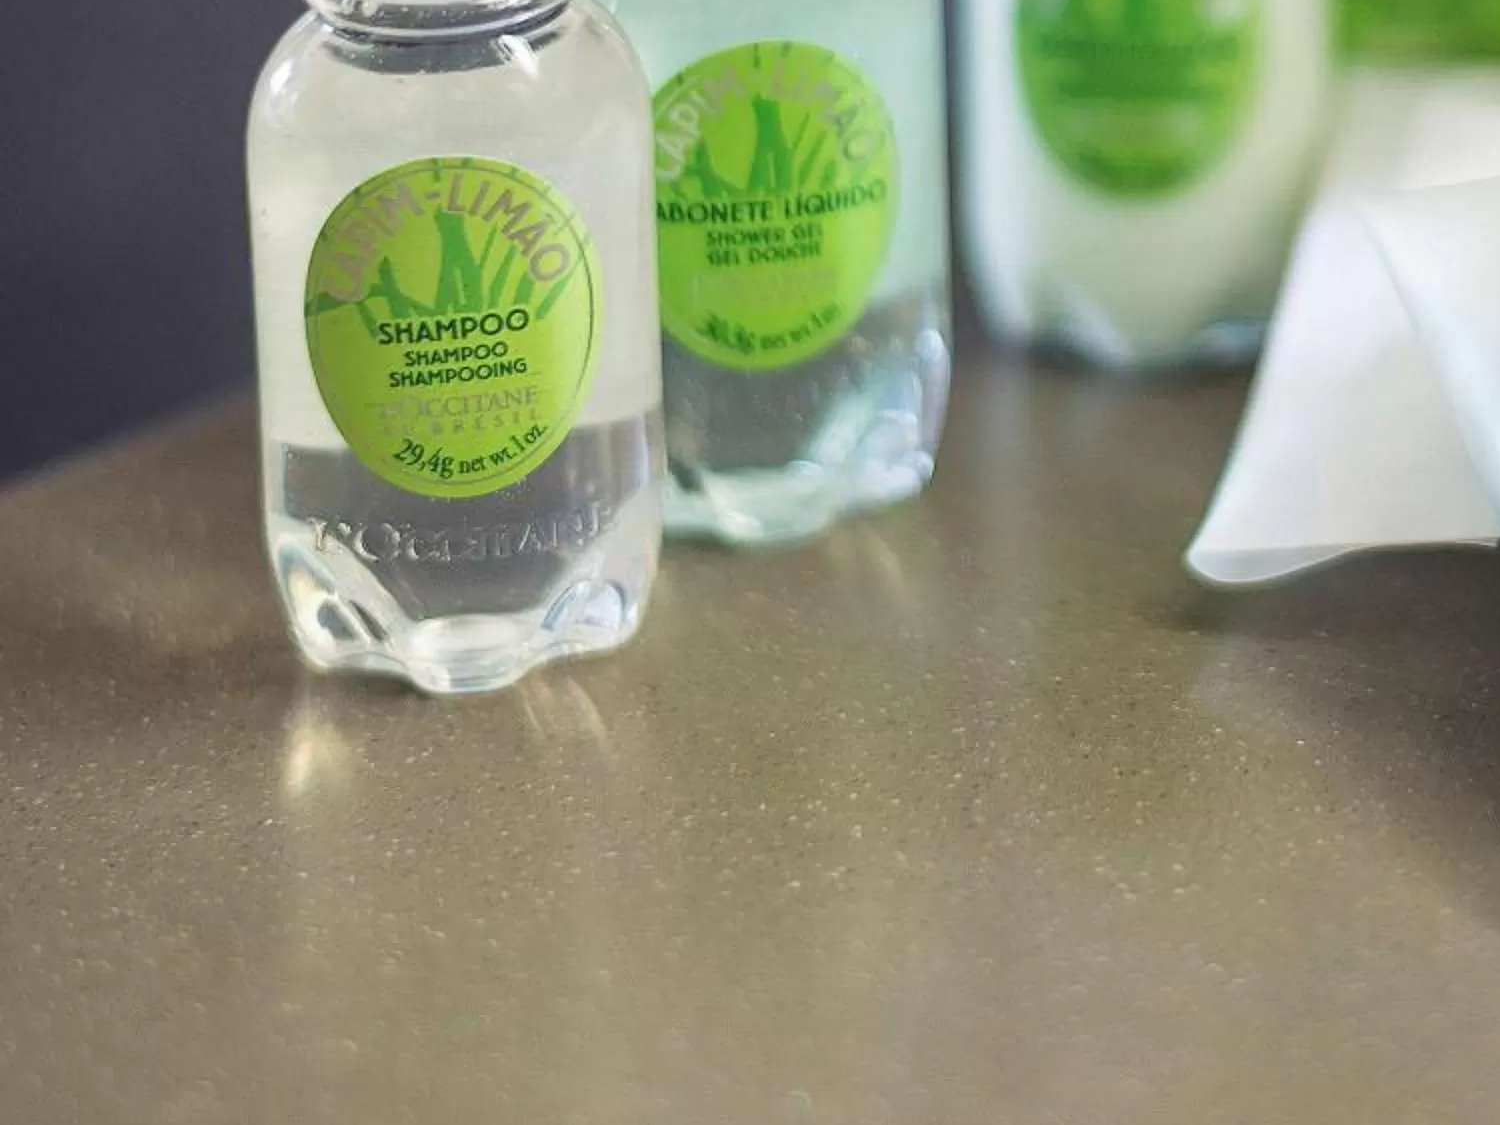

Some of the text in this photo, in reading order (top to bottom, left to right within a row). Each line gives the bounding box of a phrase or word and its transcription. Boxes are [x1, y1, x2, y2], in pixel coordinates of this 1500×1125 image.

[656, 200, 774, 224] ABONETE
[320, 173, 572, 303] CAPIM-LIMÃO
[378, 307, 530, 347] SHAMPOO
[404, 340, 509, 368] SHAMPOO
[389, 356, 528, 389] SHAMPOOING
[393, 438, 455, 480] 29,4g
[459, 454, 487, 475] net
